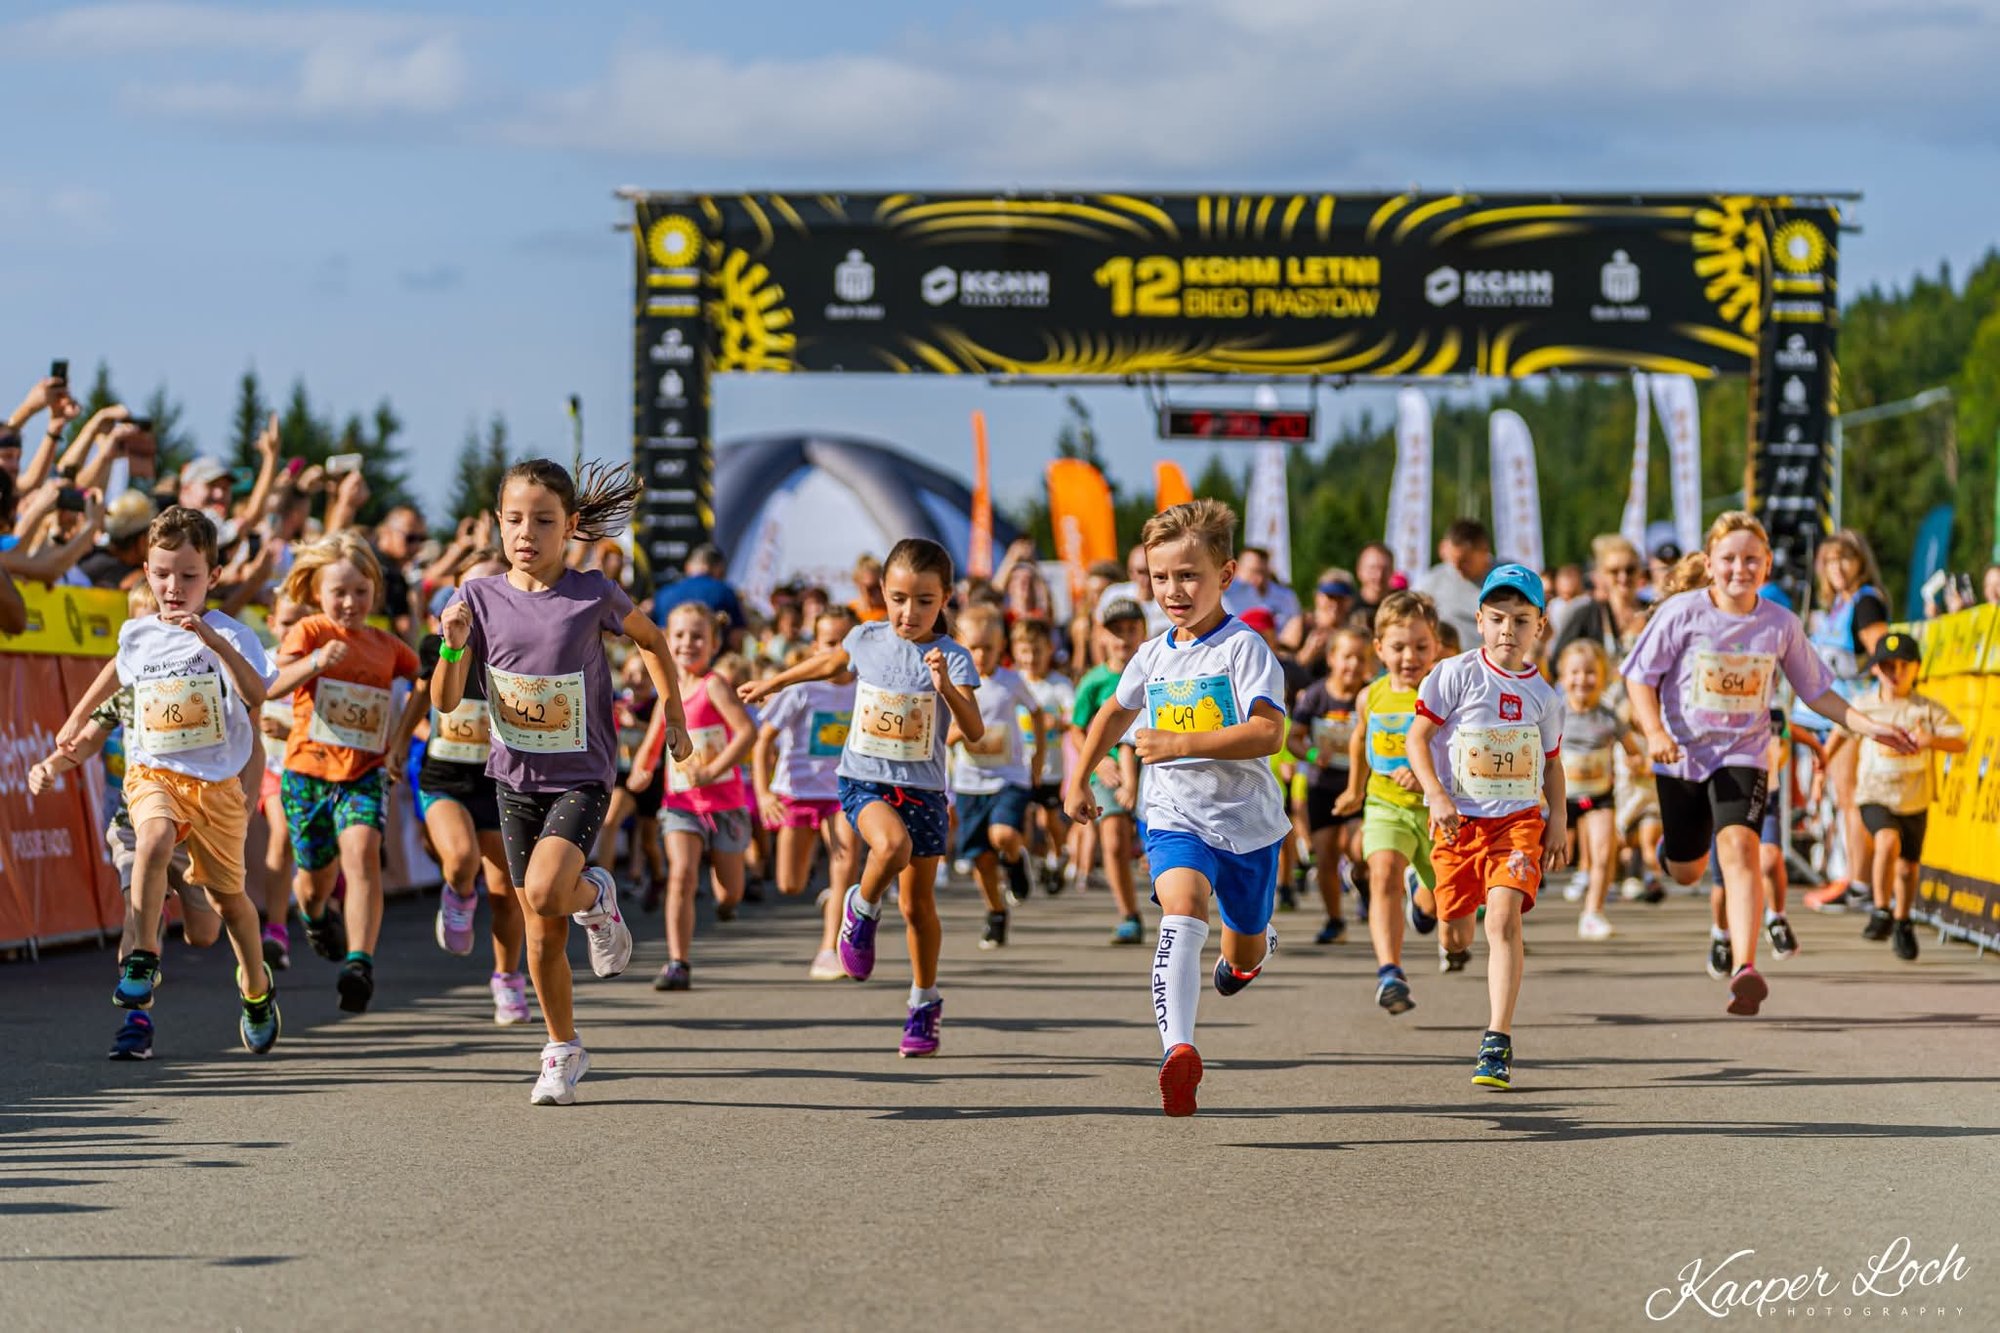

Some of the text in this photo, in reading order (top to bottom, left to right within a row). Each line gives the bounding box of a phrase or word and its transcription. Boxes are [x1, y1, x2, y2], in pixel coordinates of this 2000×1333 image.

[960, 270, 1050, 295] KGHM
[1183, 256, 1381, 286] KGHM LETNI
[1464, 270, 1554, 294] KGHM
[1095, 255, 1182, 318] 12
[1183, 288, 1250, 318] BIEG
[143, 663, 161, 674] Pan
[1721, 672, 1744, 691] 64
[162, 703, 184, 724] 18
[344, 703, 368, 726] 58
[515, 700, 546, 723] 42
[876, 711, 904, 735] 59
[1173, 706, 1195, 731] 49
[450, 719, 473, 738] 45
[1492, 751, 1514, 772] 79
[1153, 928, 1177, 1032] JUMP HIGH
